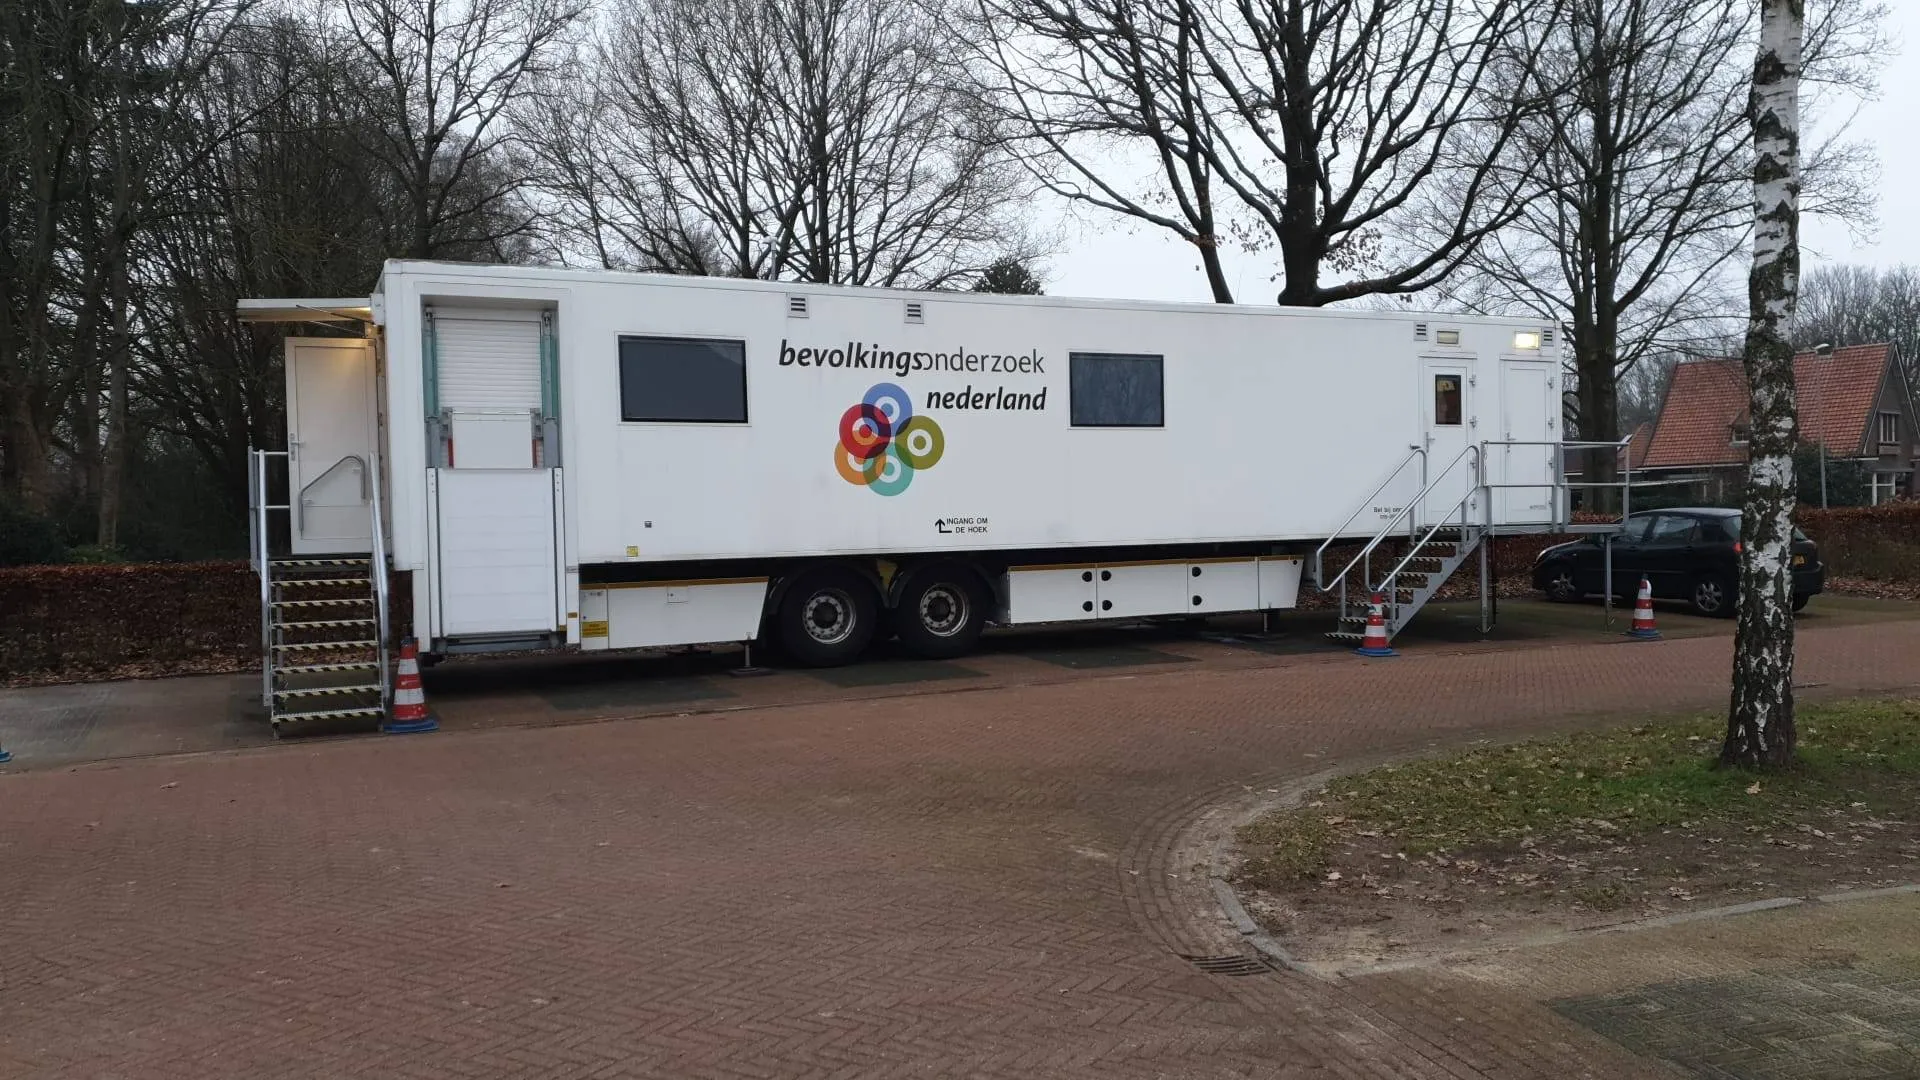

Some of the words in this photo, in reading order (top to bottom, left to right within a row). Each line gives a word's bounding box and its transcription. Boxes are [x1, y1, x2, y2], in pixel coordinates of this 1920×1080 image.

[778, 338, 1046, 377] bevolkingsonderzoek
[926, 385, 1048, 411] nederland
[946, 517, 974, 525] INGANG
[955, 526, 966, 534] DE
